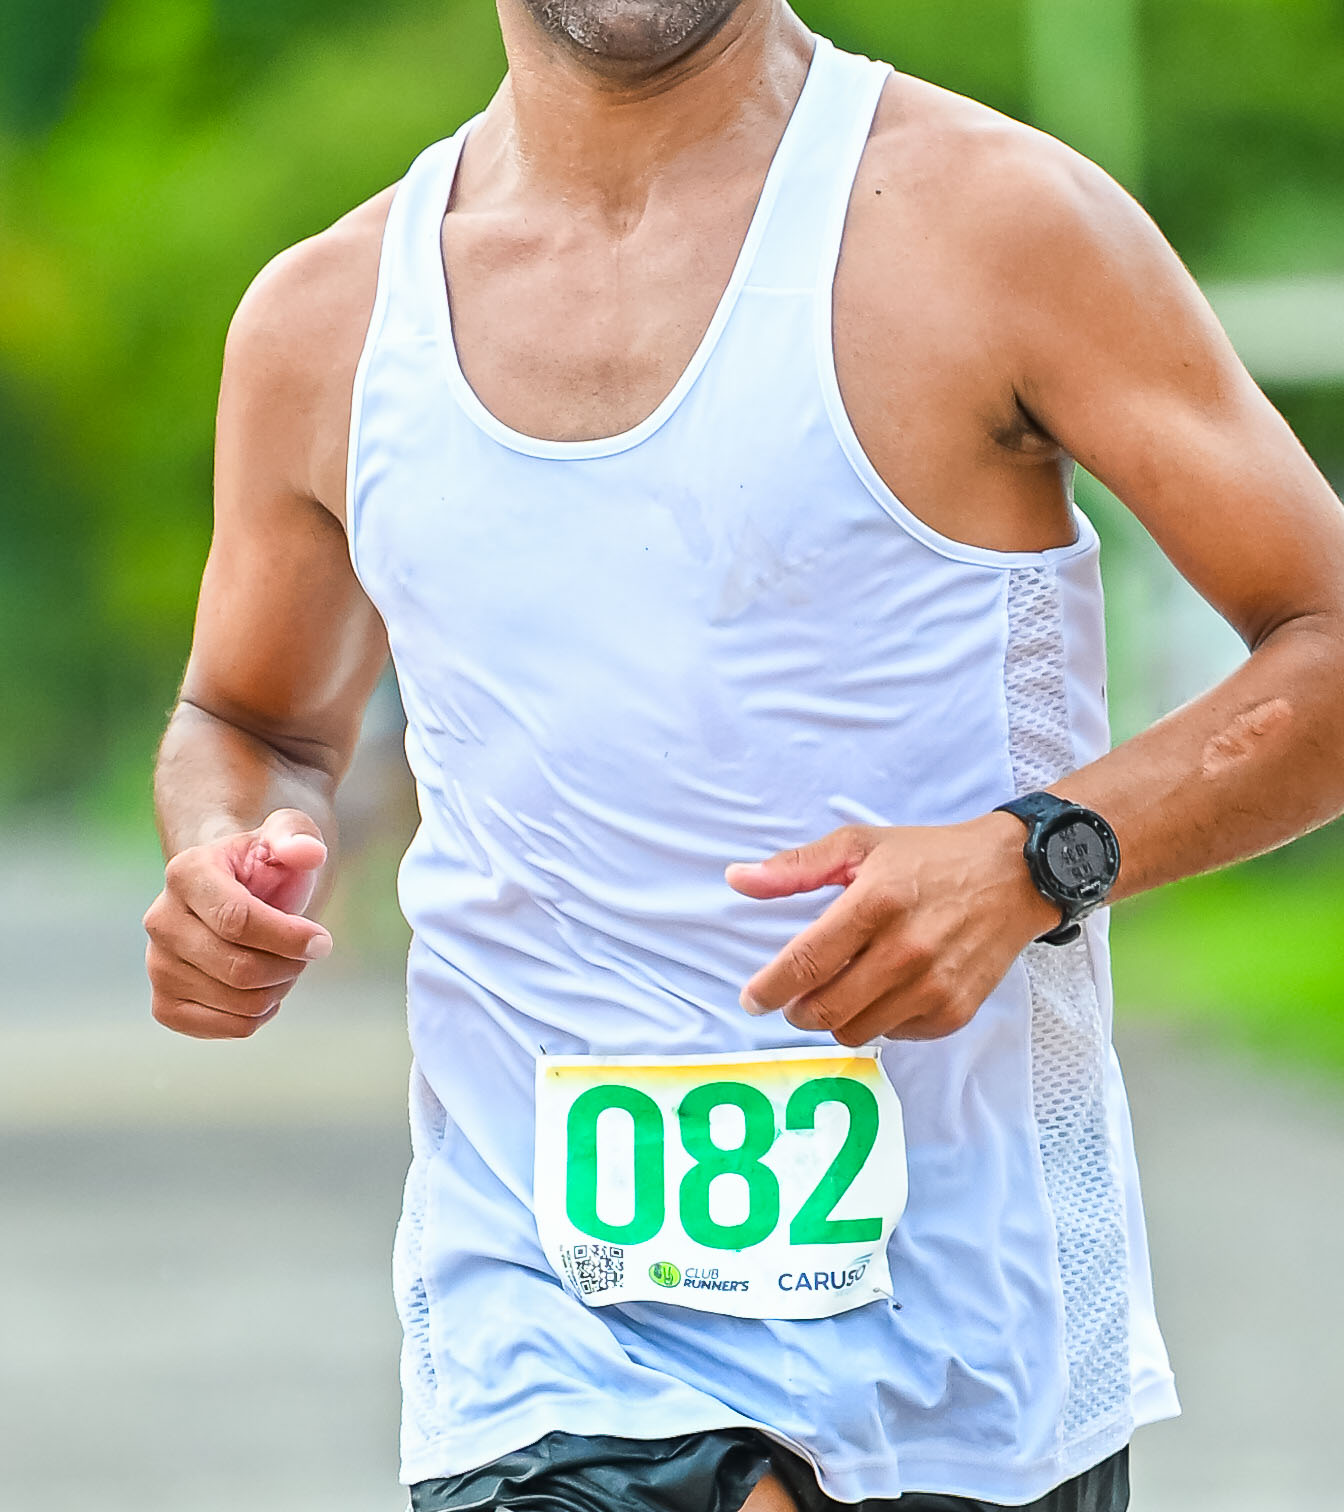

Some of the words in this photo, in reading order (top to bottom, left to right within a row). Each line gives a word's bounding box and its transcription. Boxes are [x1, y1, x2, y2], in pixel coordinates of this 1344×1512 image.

[566, 1077, 883, 1250] 082
[685, 1267, 719, 1279] CLUB
[778, 1264, 866, 1292] CARUSO
[683, 1278, 750, 1292] RUNNER'S
